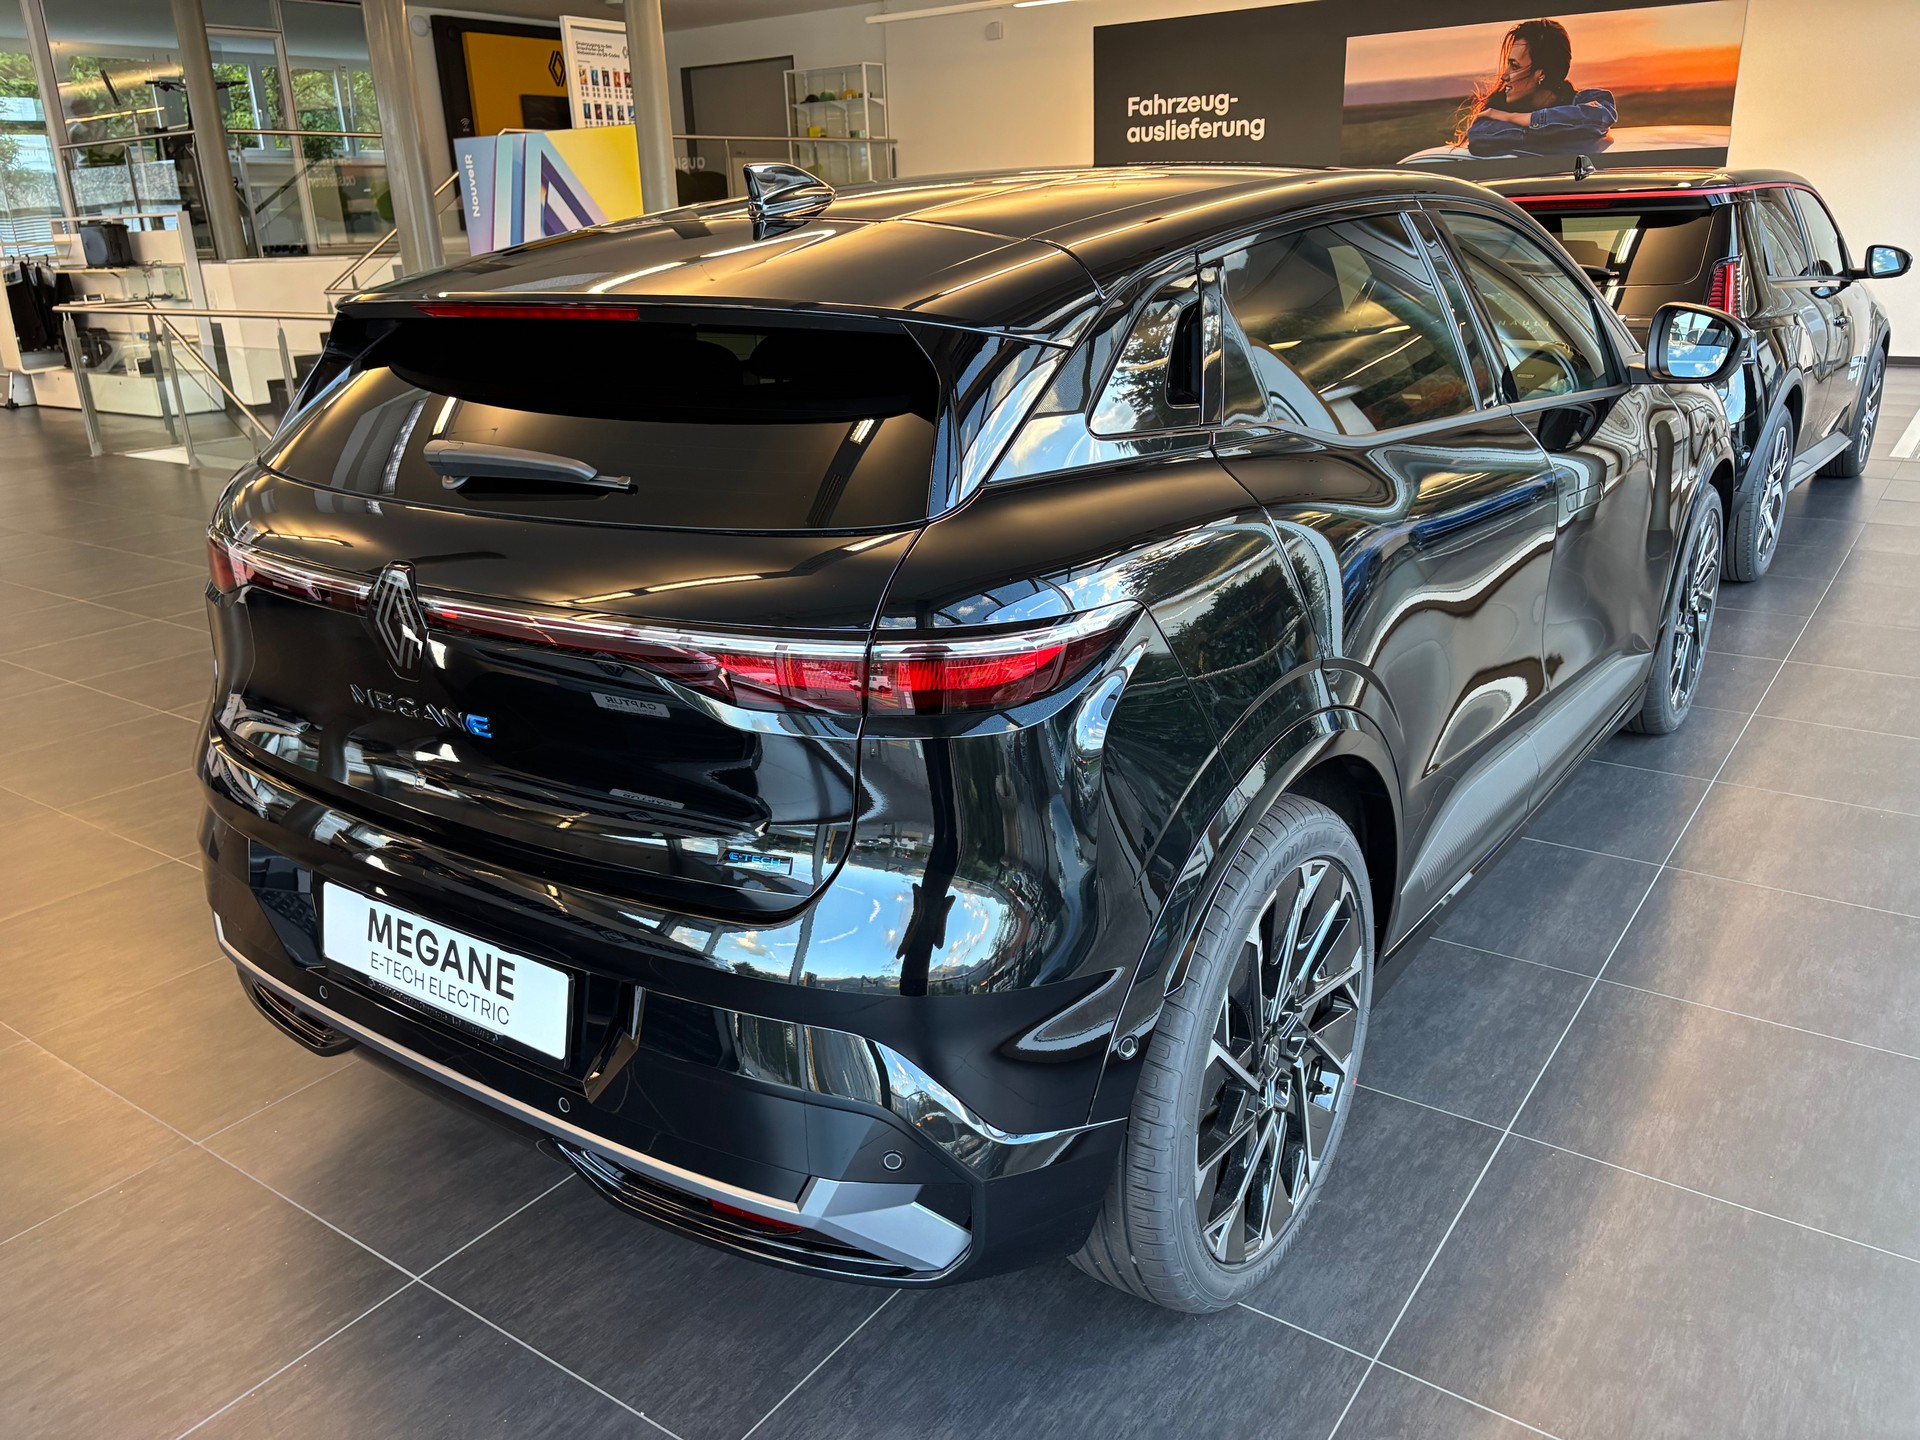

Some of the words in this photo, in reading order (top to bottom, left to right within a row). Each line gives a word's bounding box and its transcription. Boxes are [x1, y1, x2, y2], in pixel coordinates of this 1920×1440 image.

[1127, 93, 1239, 117] Fahrzeug-
[1126, 117, 1266, 143] auslieferung
[350, 683, 493, 739] MEGANE
[729, 851, 783, 867] E-TECH
[367, 907, 516, 1001] MEGANE
[370, 951, 425, 991] E-TECH
[429, 976, 510, 1026] ELECTRIC
